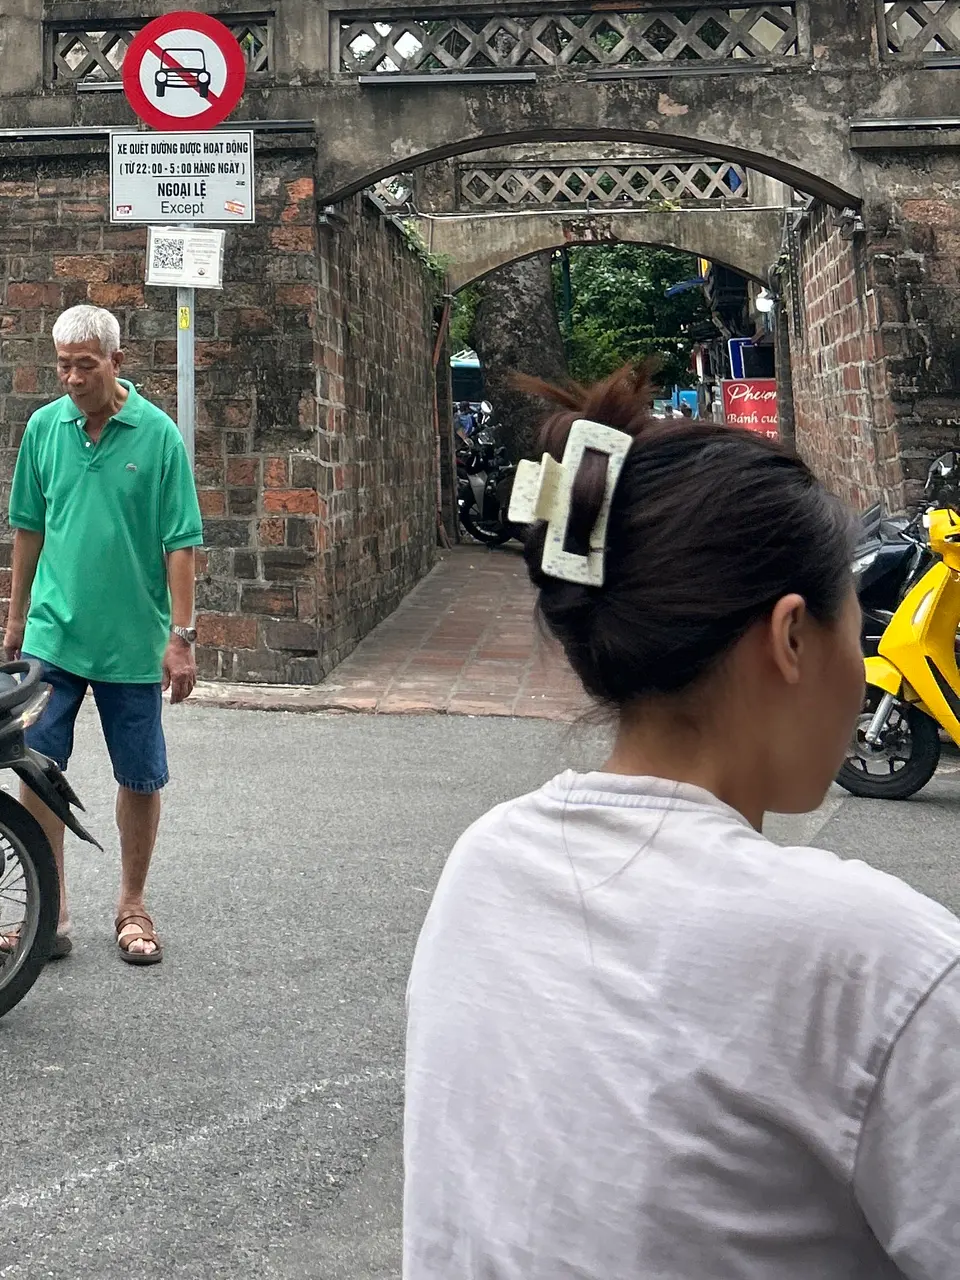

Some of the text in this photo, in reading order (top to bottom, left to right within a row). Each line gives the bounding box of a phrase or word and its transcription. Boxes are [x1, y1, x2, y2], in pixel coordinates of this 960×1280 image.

[117, 139, 248, 157] XE QUÉT ĐƯỜNG ĐƯỢC HOẠT ĐỘNG
[193, 159, 216, 174] HÀNG
[157, 179, 207, 199] NGOẠI LỆ
[161, 200, 205, 216] Except
[727, 410, 759, 424] Bánh
